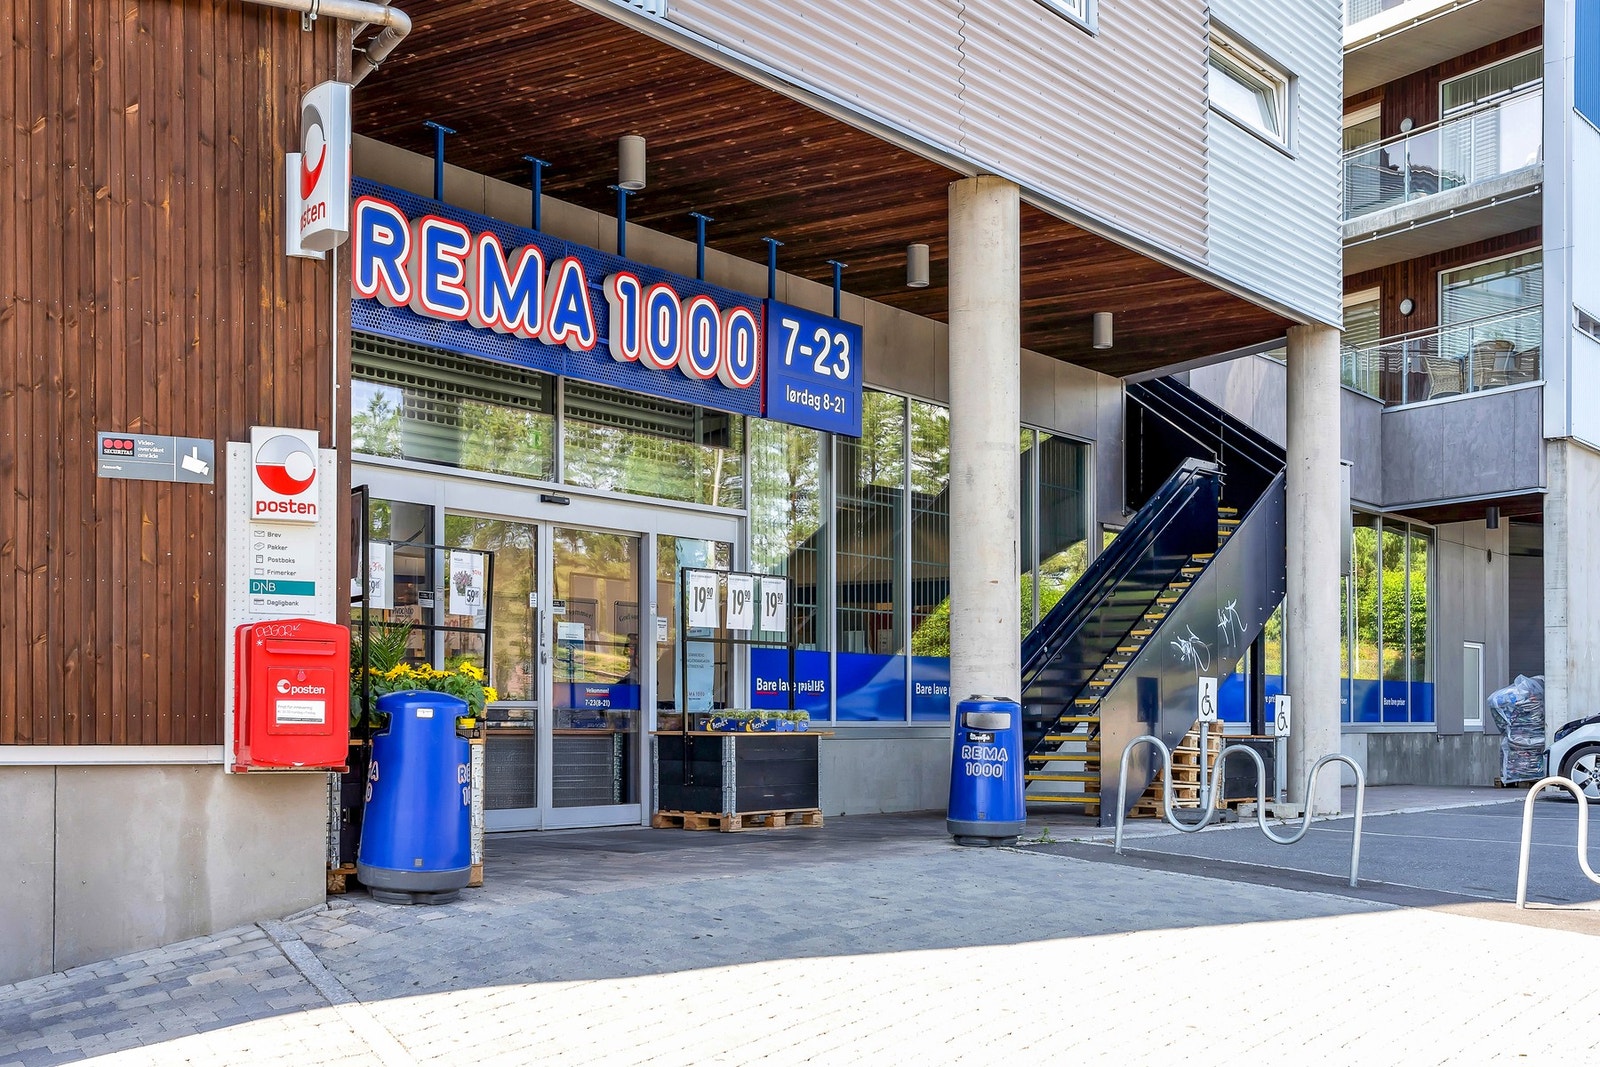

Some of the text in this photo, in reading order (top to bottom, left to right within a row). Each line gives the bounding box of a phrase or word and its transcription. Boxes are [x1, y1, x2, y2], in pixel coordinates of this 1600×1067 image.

[352, 195, 759, 390] REMA 1000
[782, 318, 851, 380] 7-23
[786, 384, 846, 414] lørdag 8-21
[256, 499, 317, 515] posten
[267, 531, 282, 539] Brev
[267, 543, 288, 551] Pakker
[267, 556, 295, 564] Postboks
[252, 579, 276, 594] DNB
[267, 599, 299, 607] Dagligbank
[291, 685, 325, 695] posten
[756, 677, 777, 691] Bare
[915, 682, 932, 694] Bare
[933, 683, 948, 695] lave
[962, 745, 1008, 762] REMA
[965, 761, 1003, 778] 1000
